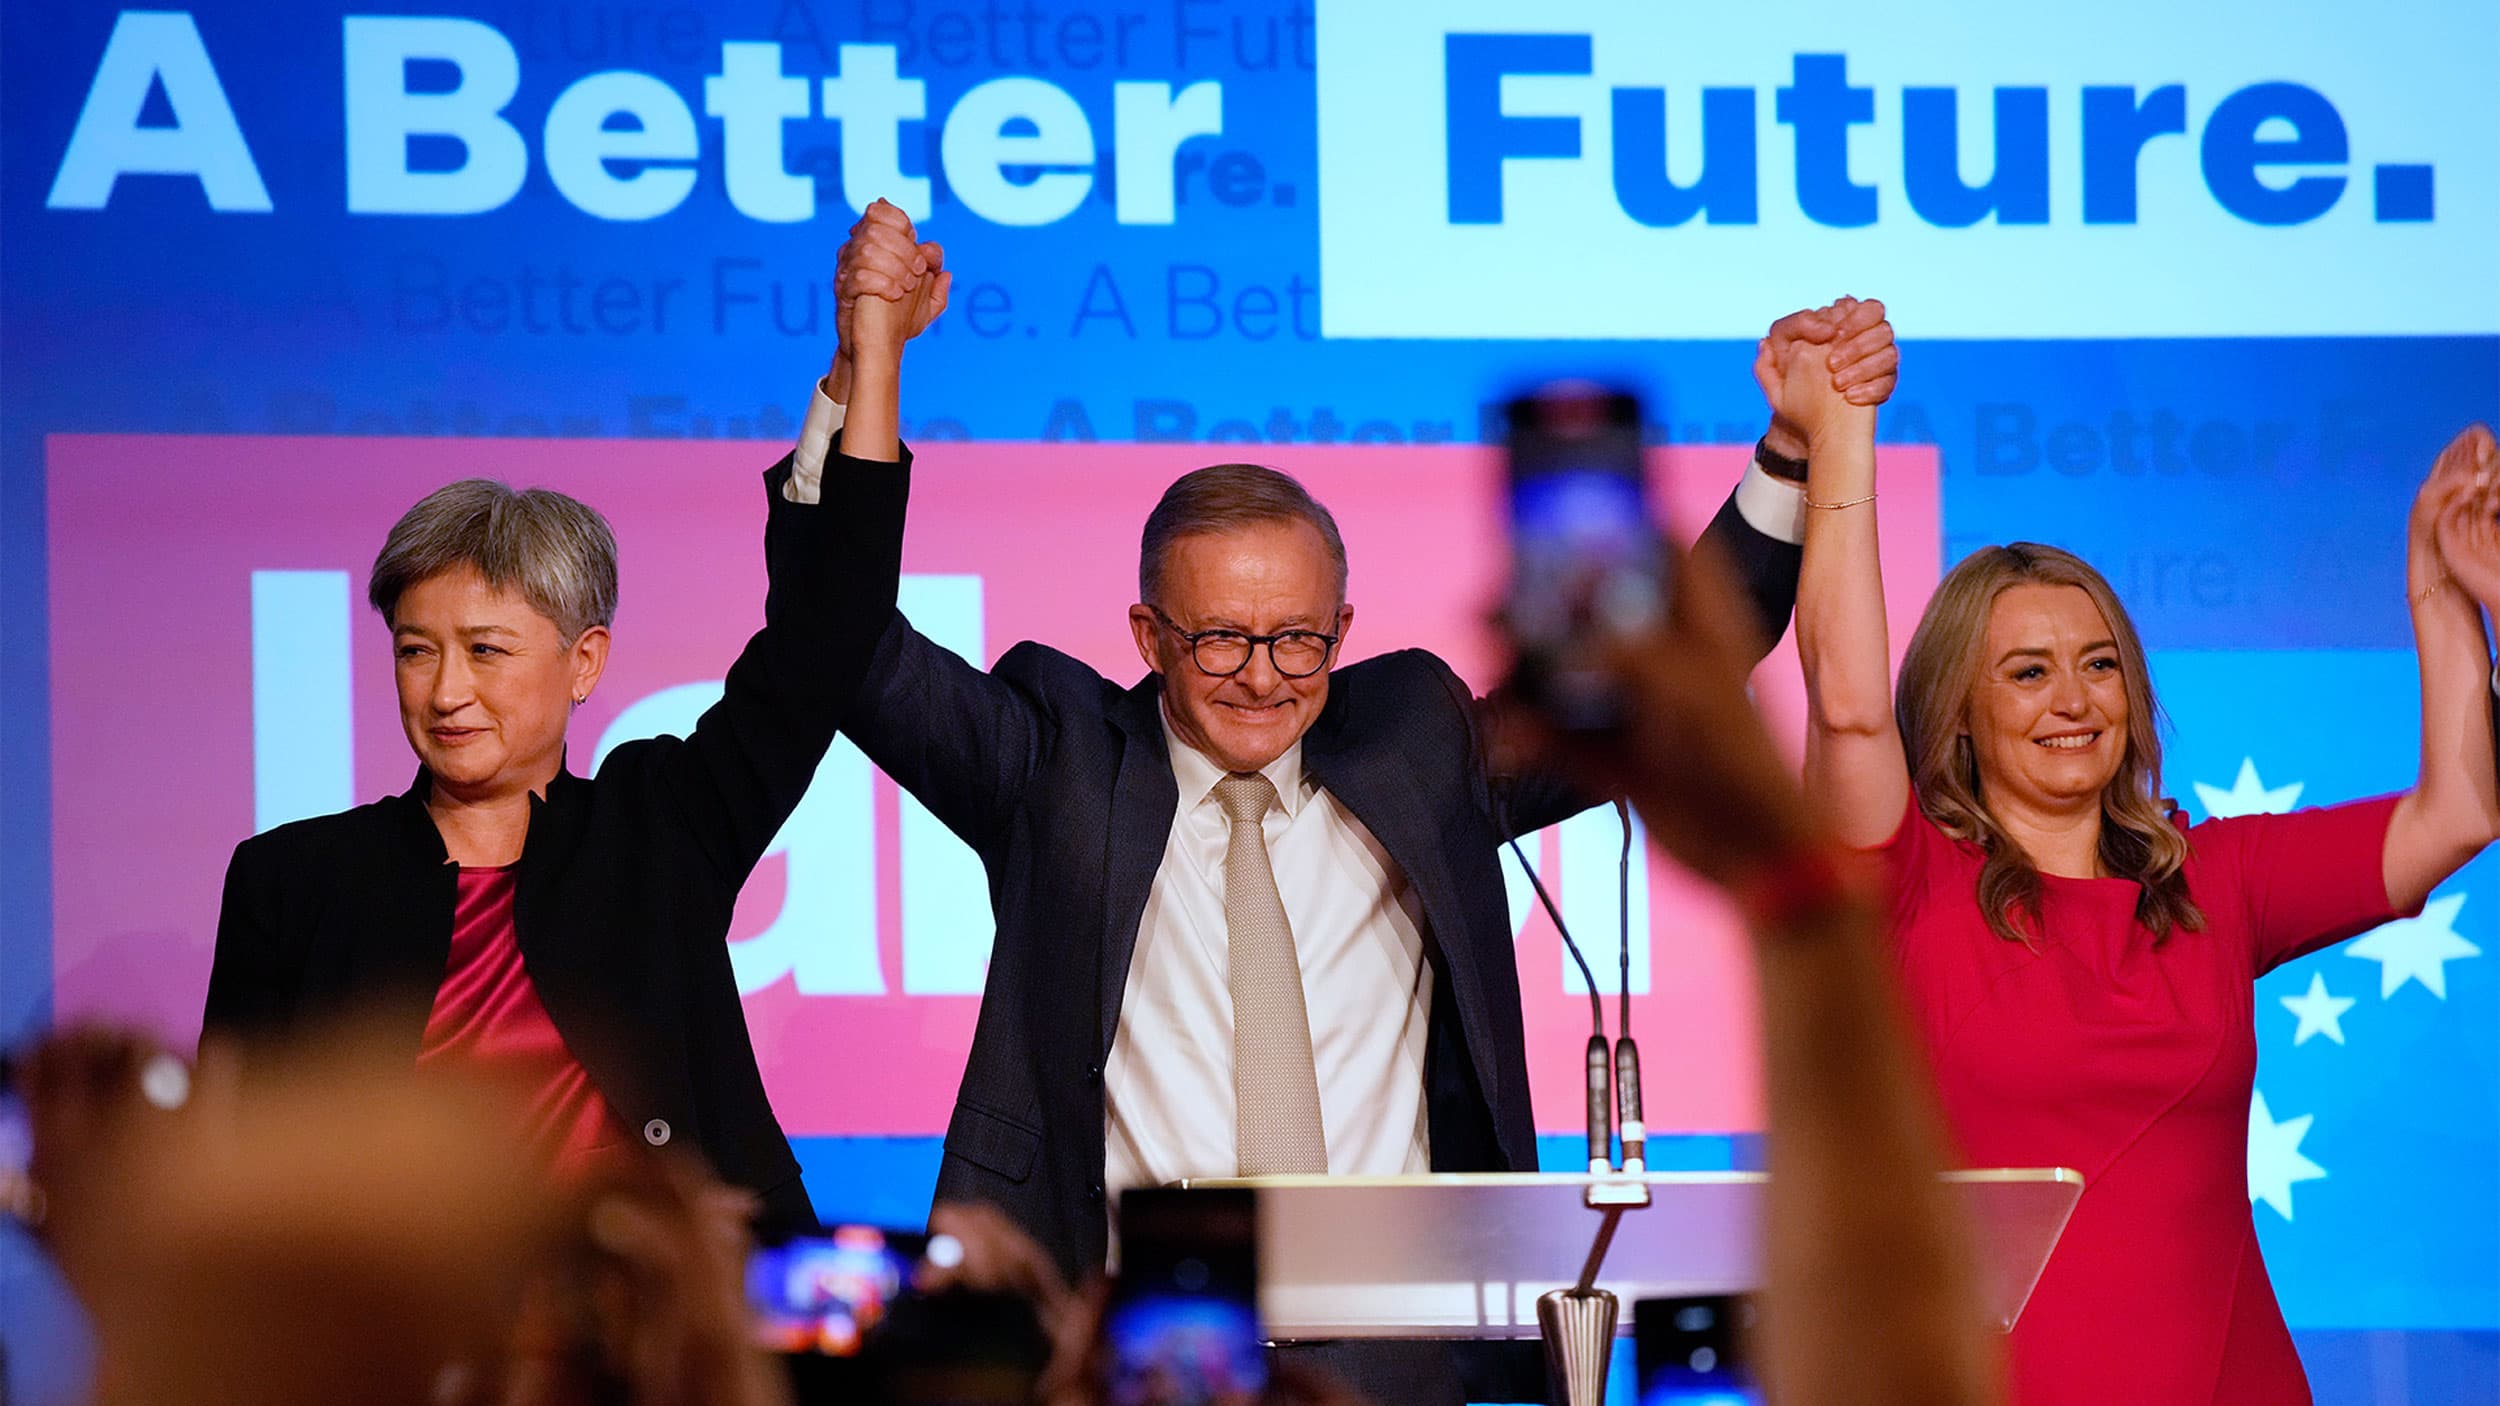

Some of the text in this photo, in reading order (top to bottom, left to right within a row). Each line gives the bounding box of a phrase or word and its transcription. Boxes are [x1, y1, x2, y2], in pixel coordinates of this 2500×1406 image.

[45, 10, 274, 214] A
[343, 14, 1223, 227] Better
[1444, 32, 2436, 229] Future.
[392, 246, 687, 336] Better
[711, 256, 1041, 340] Fure.
[1069, 261, 1139, 342] A
[1974, 401, 2296, 479] Better
